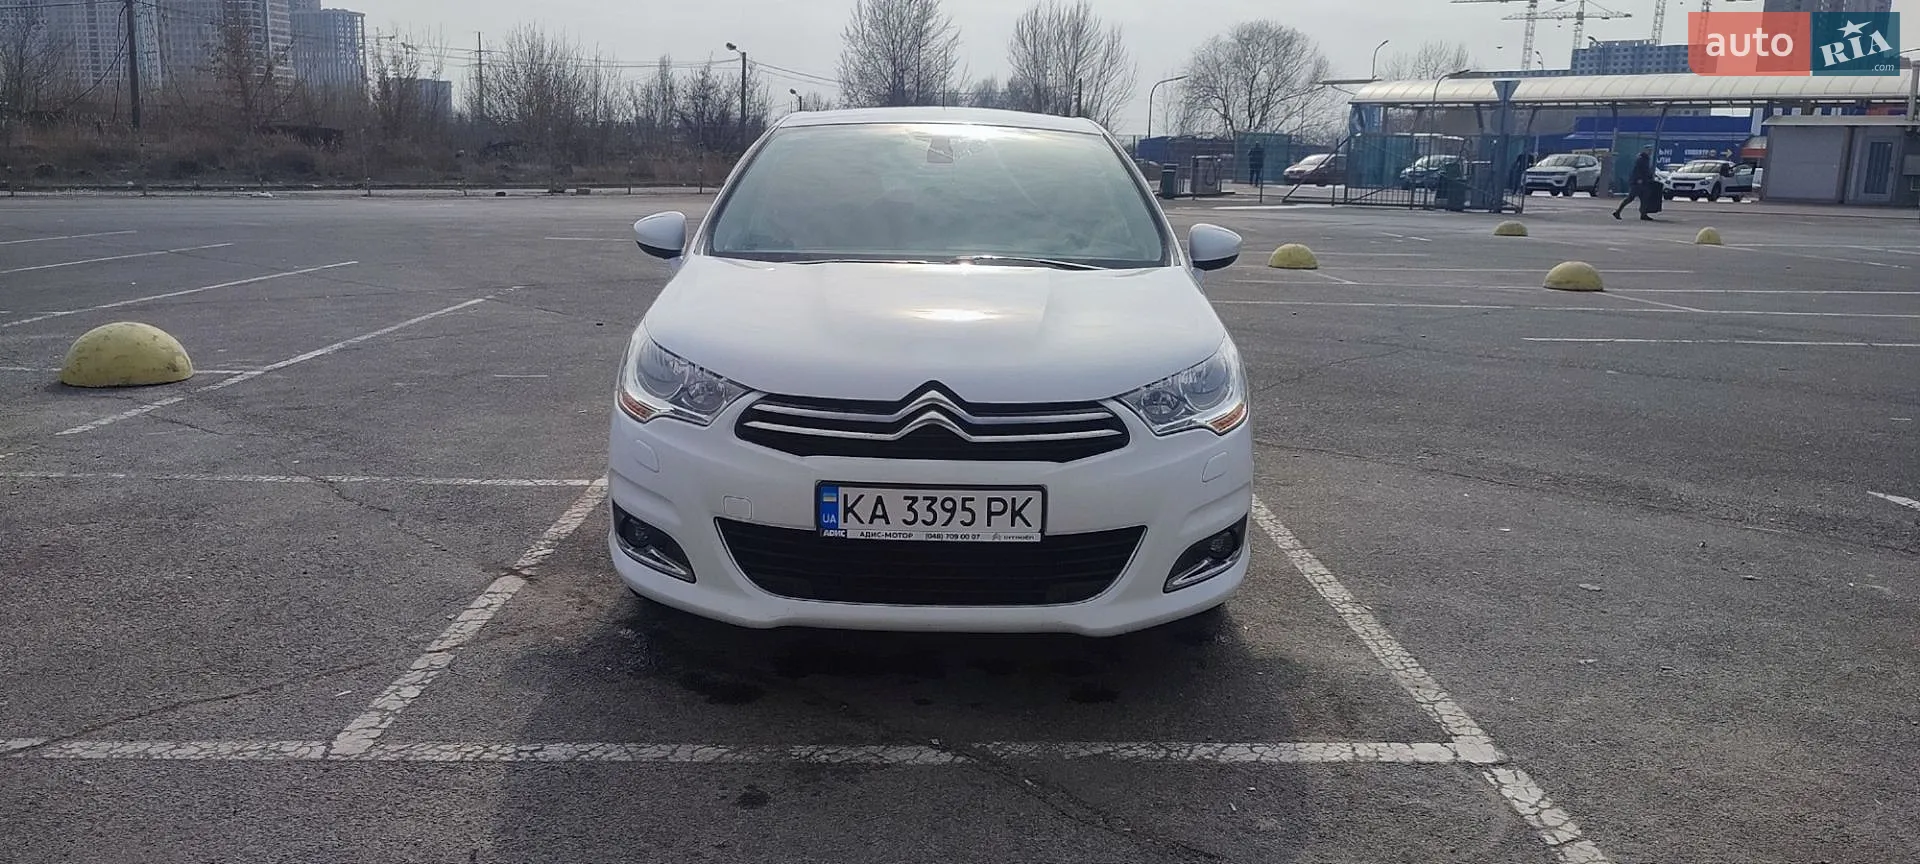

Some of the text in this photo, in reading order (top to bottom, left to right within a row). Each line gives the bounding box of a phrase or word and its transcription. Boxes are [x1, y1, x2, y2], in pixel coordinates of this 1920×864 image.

[843, 493, 1033, 527] KA 3395 PK
[823, 513, 837, 523] UA
[860, 531, 913, 539] АДИС-МОТОР
